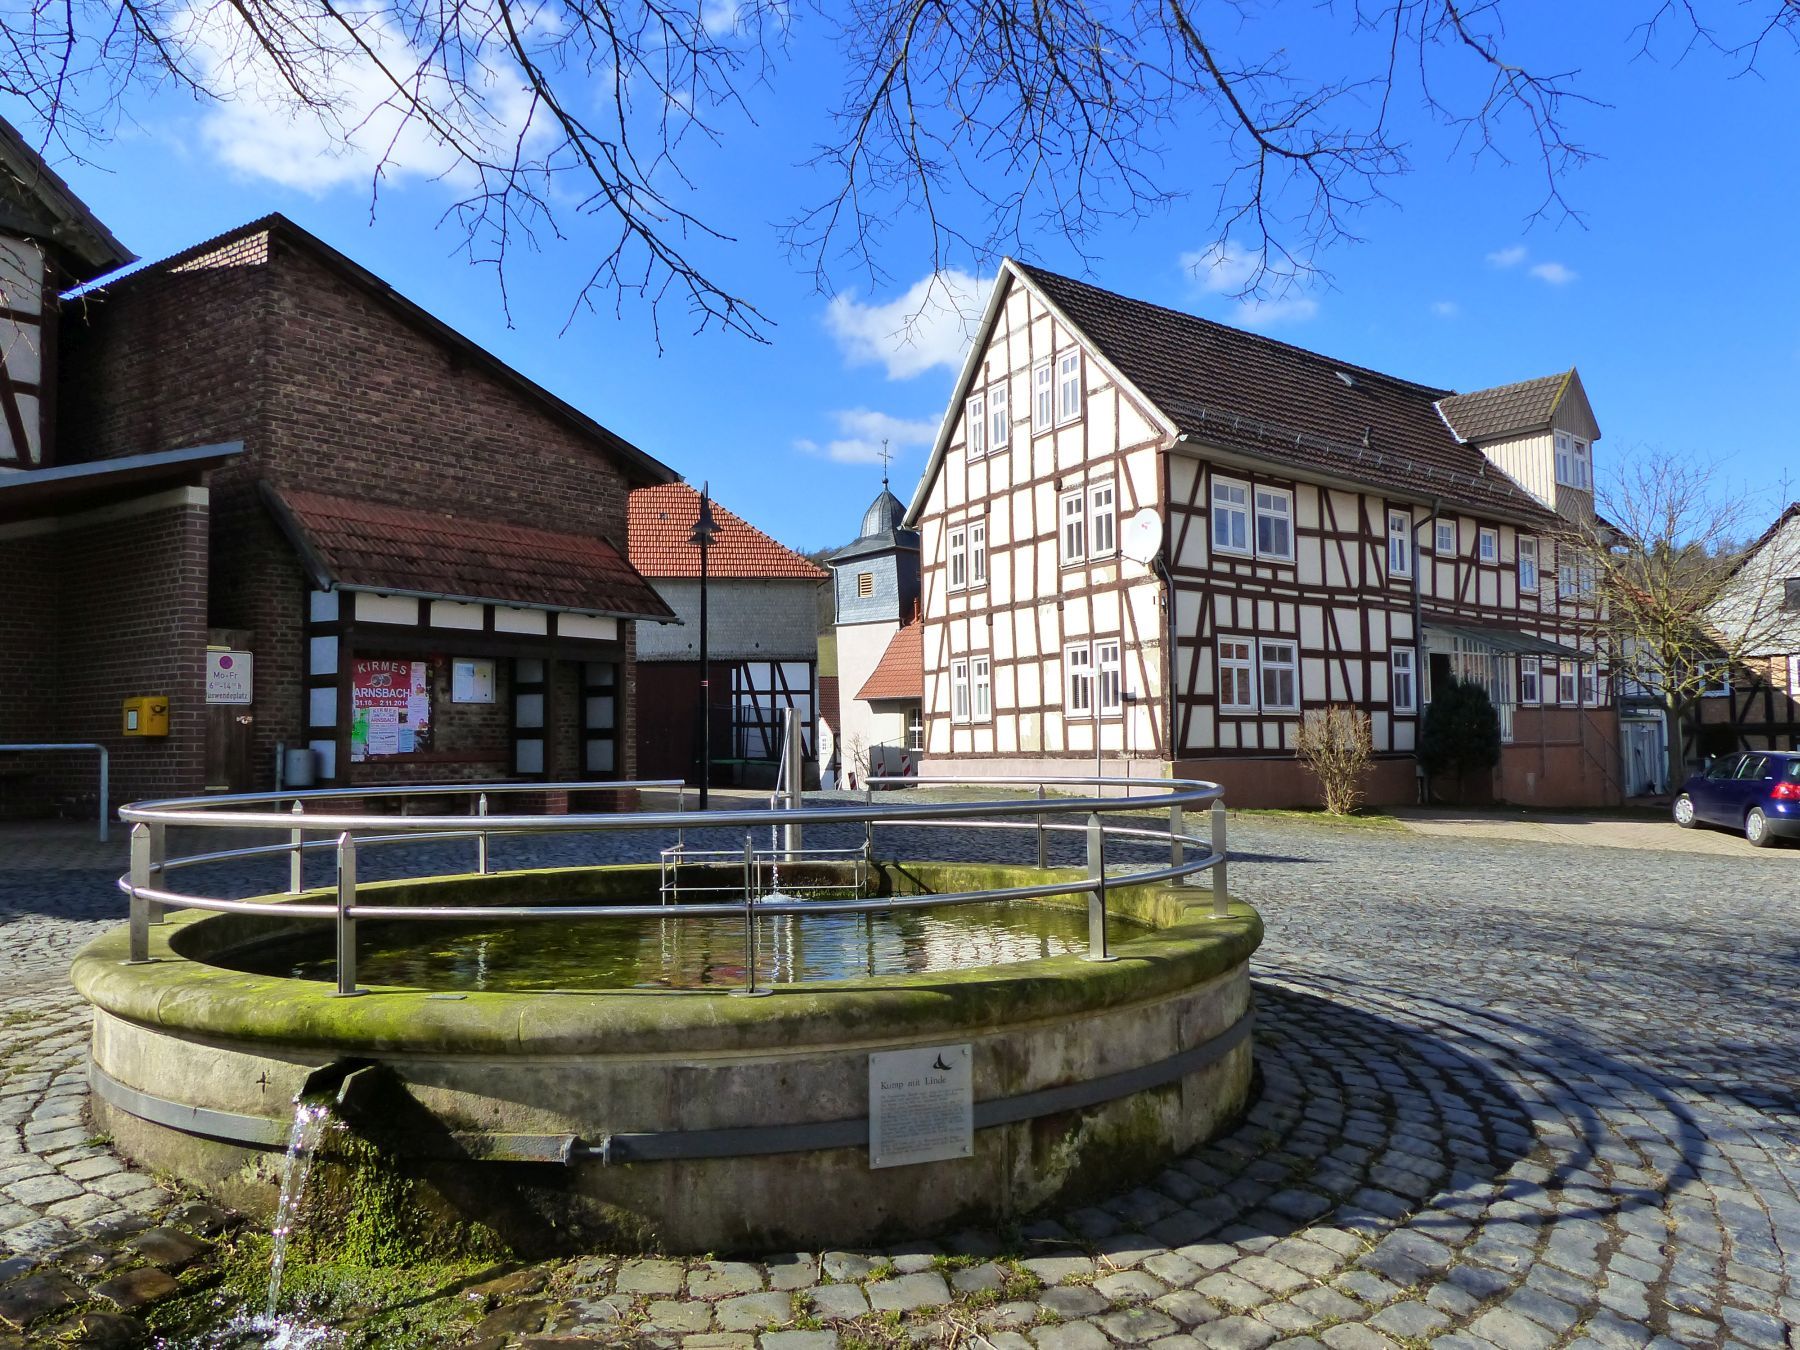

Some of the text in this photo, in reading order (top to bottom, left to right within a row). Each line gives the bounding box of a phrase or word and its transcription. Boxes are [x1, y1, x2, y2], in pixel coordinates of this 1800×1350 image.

[357, 661, 407, 675] KIRMES
[354, 688, 410, 698] ARNSBACH
[880, 1080, 904, 1090] Kump
[925, 1076, 947, 1086] Linde
